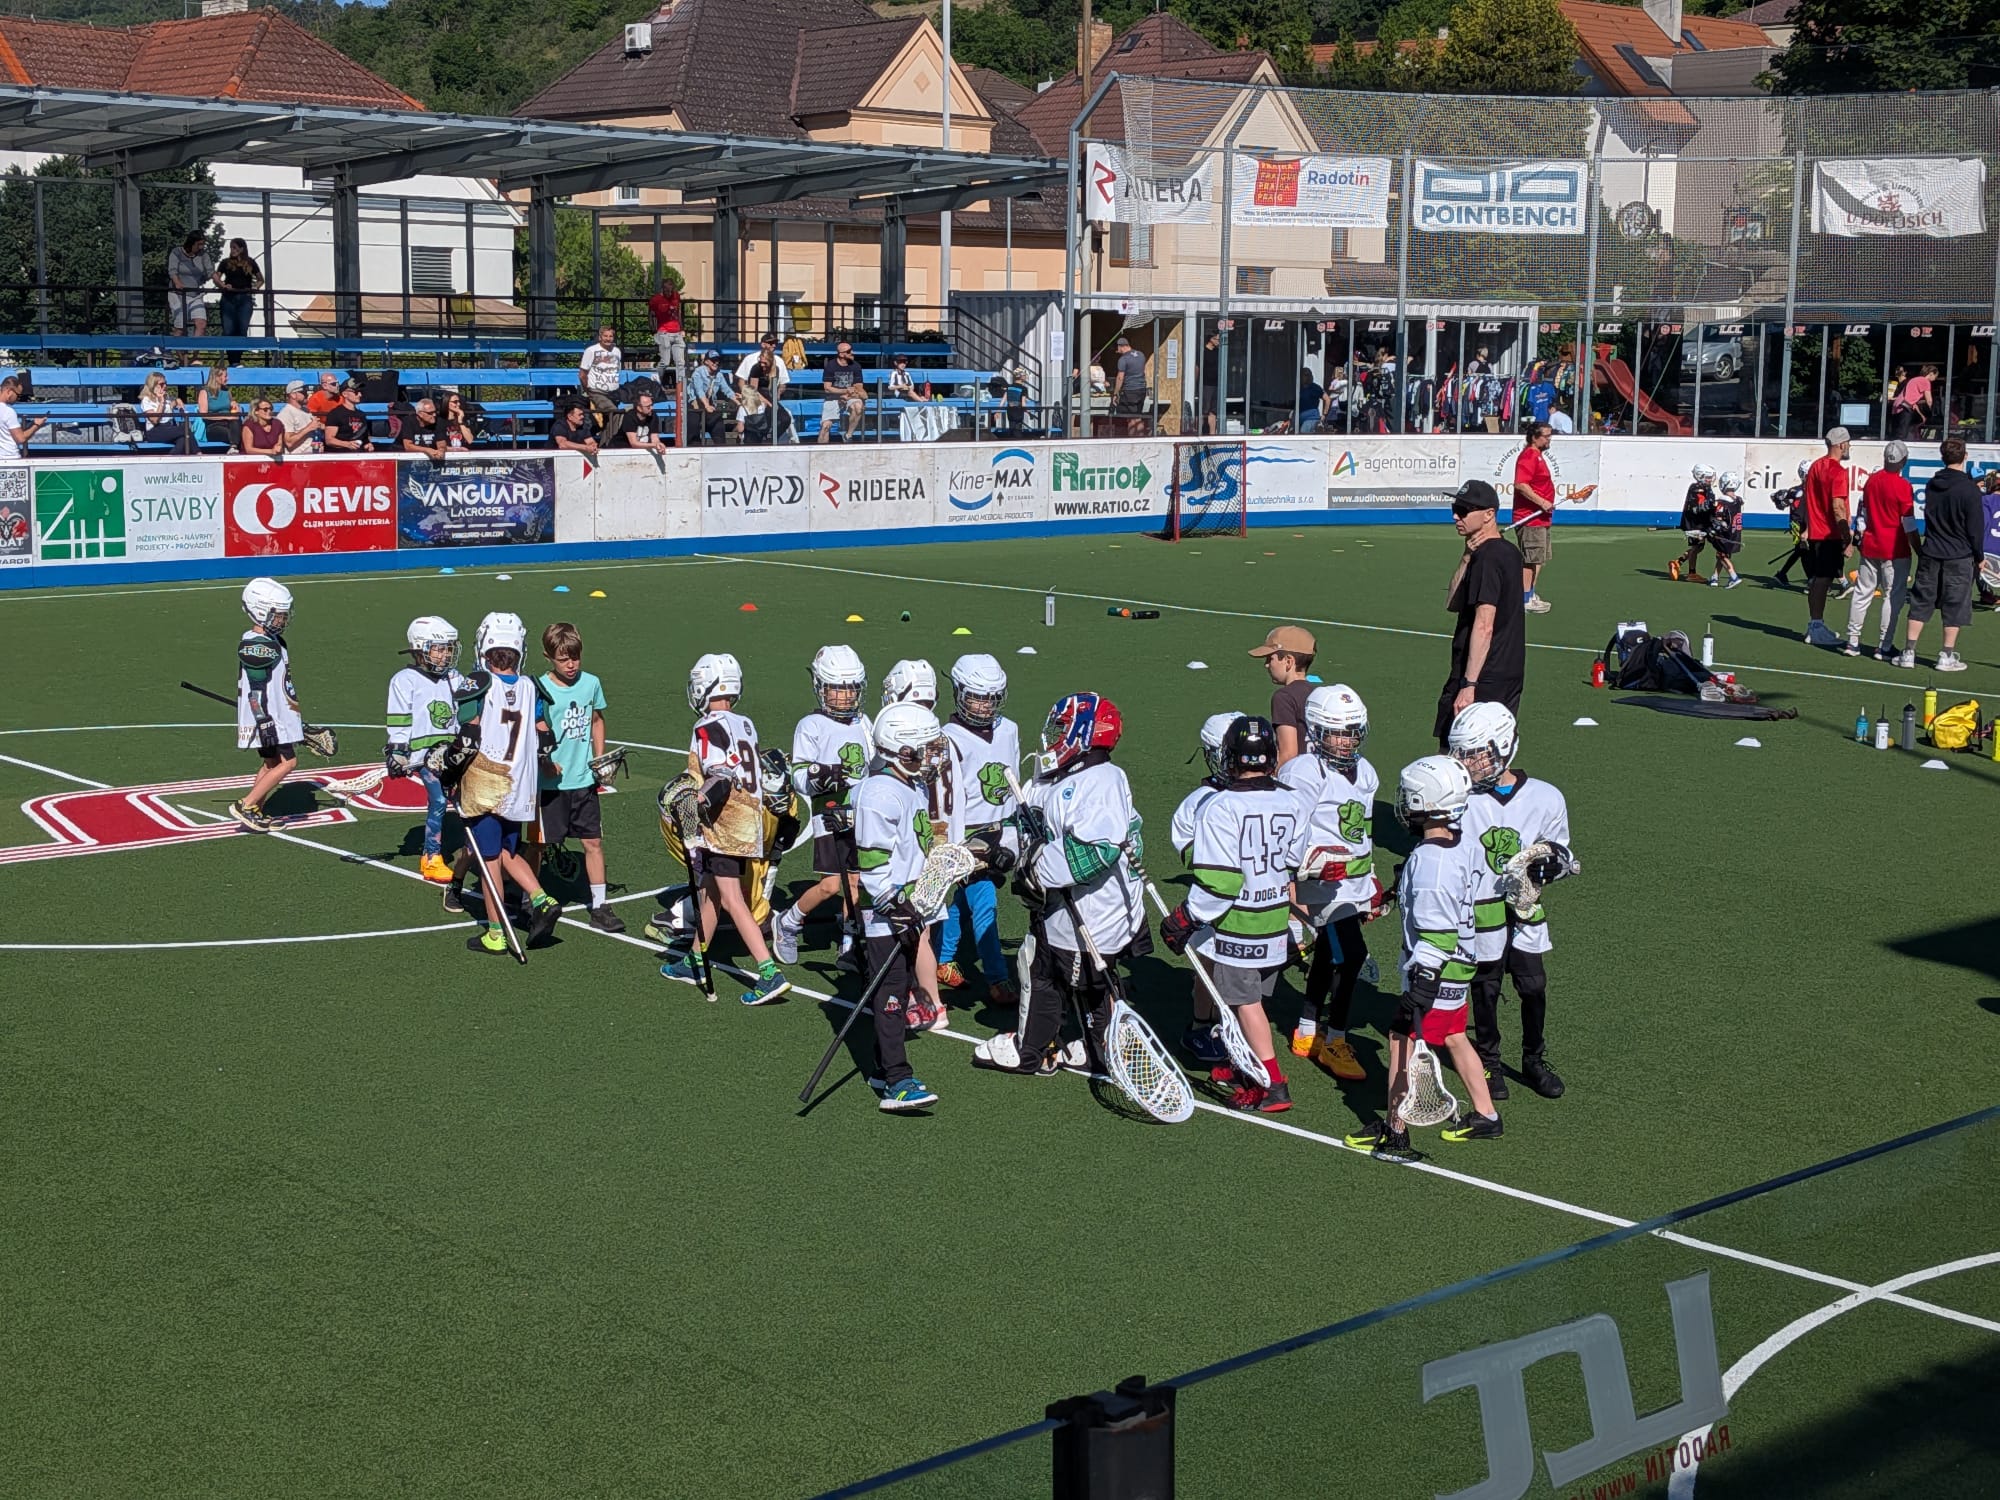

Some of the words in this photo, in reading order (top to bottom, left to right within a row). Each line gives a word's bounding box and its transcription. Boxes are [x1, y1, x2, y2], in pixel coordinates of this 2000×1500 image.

[1422, 205, 1577, 226] POINTBENCH
[144, 472, 203, 485] www.k4h.eu
[463, 467, 482, 475] YOUR
[948, 468, 1034, 491] Kine-MAX
[303, 485, 391, 514] REVIS
[417, 482, 544, 507] VANGUARD
[848, 477, 926, 502] RIDERA
[130, 496, 218, 523] STAVBY
[450, 506, 505, 518] LACROSSE
[1054, 498, 1150, 516] WWW.RATIO.CZ
[0, 536, 24, 548] OAT
[500, 708, 523, 762] 7
[1239, 813, 1297, 877] 43
[1219, 942, 1266, 959] ISSPO
